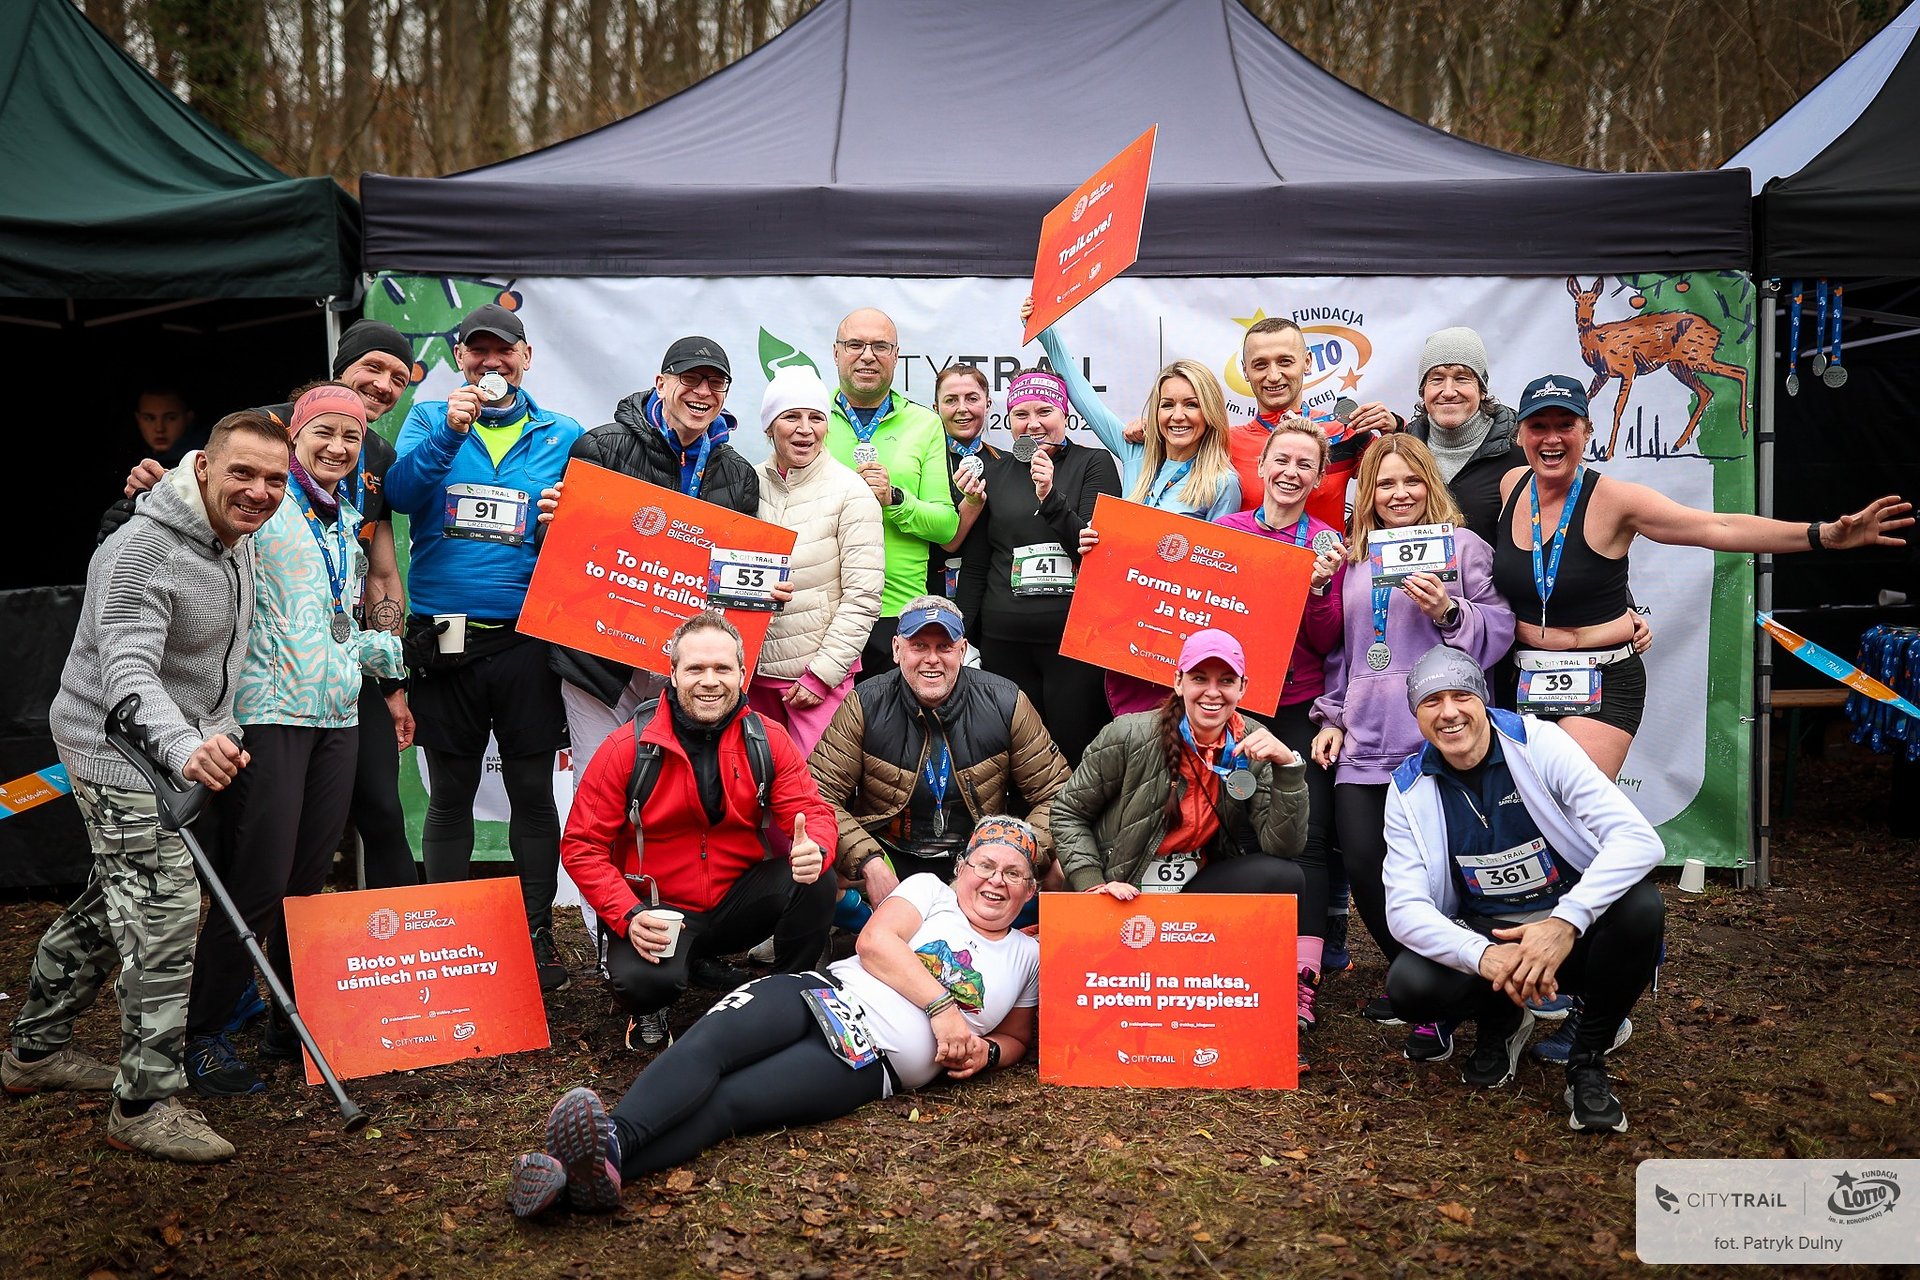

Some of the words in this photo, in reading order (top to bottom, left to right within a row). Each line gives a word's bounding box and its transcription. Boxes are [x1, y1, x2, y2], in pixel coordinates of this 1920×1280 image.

[1292, 307, 1364, 327] FUNDACJA
[1226, 400, 1243, 415] im.
[1248, 407, 1255, 416] H
[475, 502, 498, 519] 91
[671, 520, 704, 535] SKLEP
[667, 528, 716, 549] BIEGACZA
[1193, 545, 1225, 559] SKLEP
[1399, 543, 1427, 562] 87
[616, 548, 637, 568] To
[640, 560, 669, 578] nie
[671, 571, 708, 593] pot,
[1036, 559, 1055, 573] 41
[1190, 554, 1238, 574] BIEGACZA
[586, 561, 605, 578] to
[608, 570, 649, 592] rosa
[737, 569, 764, 587] 53
[1127, 568, 1181, 596] Forma
[1186, 587, 1201, 601] w
[1205, 590, 1250, 615] lesie.
[1154, 600, 1174, 617] Ja
[1179, 607, 1211, 627] też!
[1546, 674, 1572, 691] 39
[487, 764, 502, 772] PR
[1158, 864, 1185, 881] 63
[1486, 863, 1530, 885] 361
[404, 910, 437, 921] SKLEP
[404, 918, 456, 931] BIEGACZA
[1161, 922, 1197, 931] SKLEP
[1160, 933, 1216, 943] BIEGACZA
[347, 955, 397, 972] Błoto
[400, 954, 415, 964] w
[419, 944, 484, 963] butach,
[337, 970, 411, 991] uśmiech
[416, 969, 437, 981] na
[441, 960, 498, 978] twarzy
[1085, 972, 1151, 991] Zacznij
[1156, 977, 1179, 988] na
[1184, 974, 1250, 991] maksa,
[1076, 995, 1088, 1006] a
[1093, 992, 1152, 1010] potem
[1157, 992, 1259, 1010] przyspiesz!
